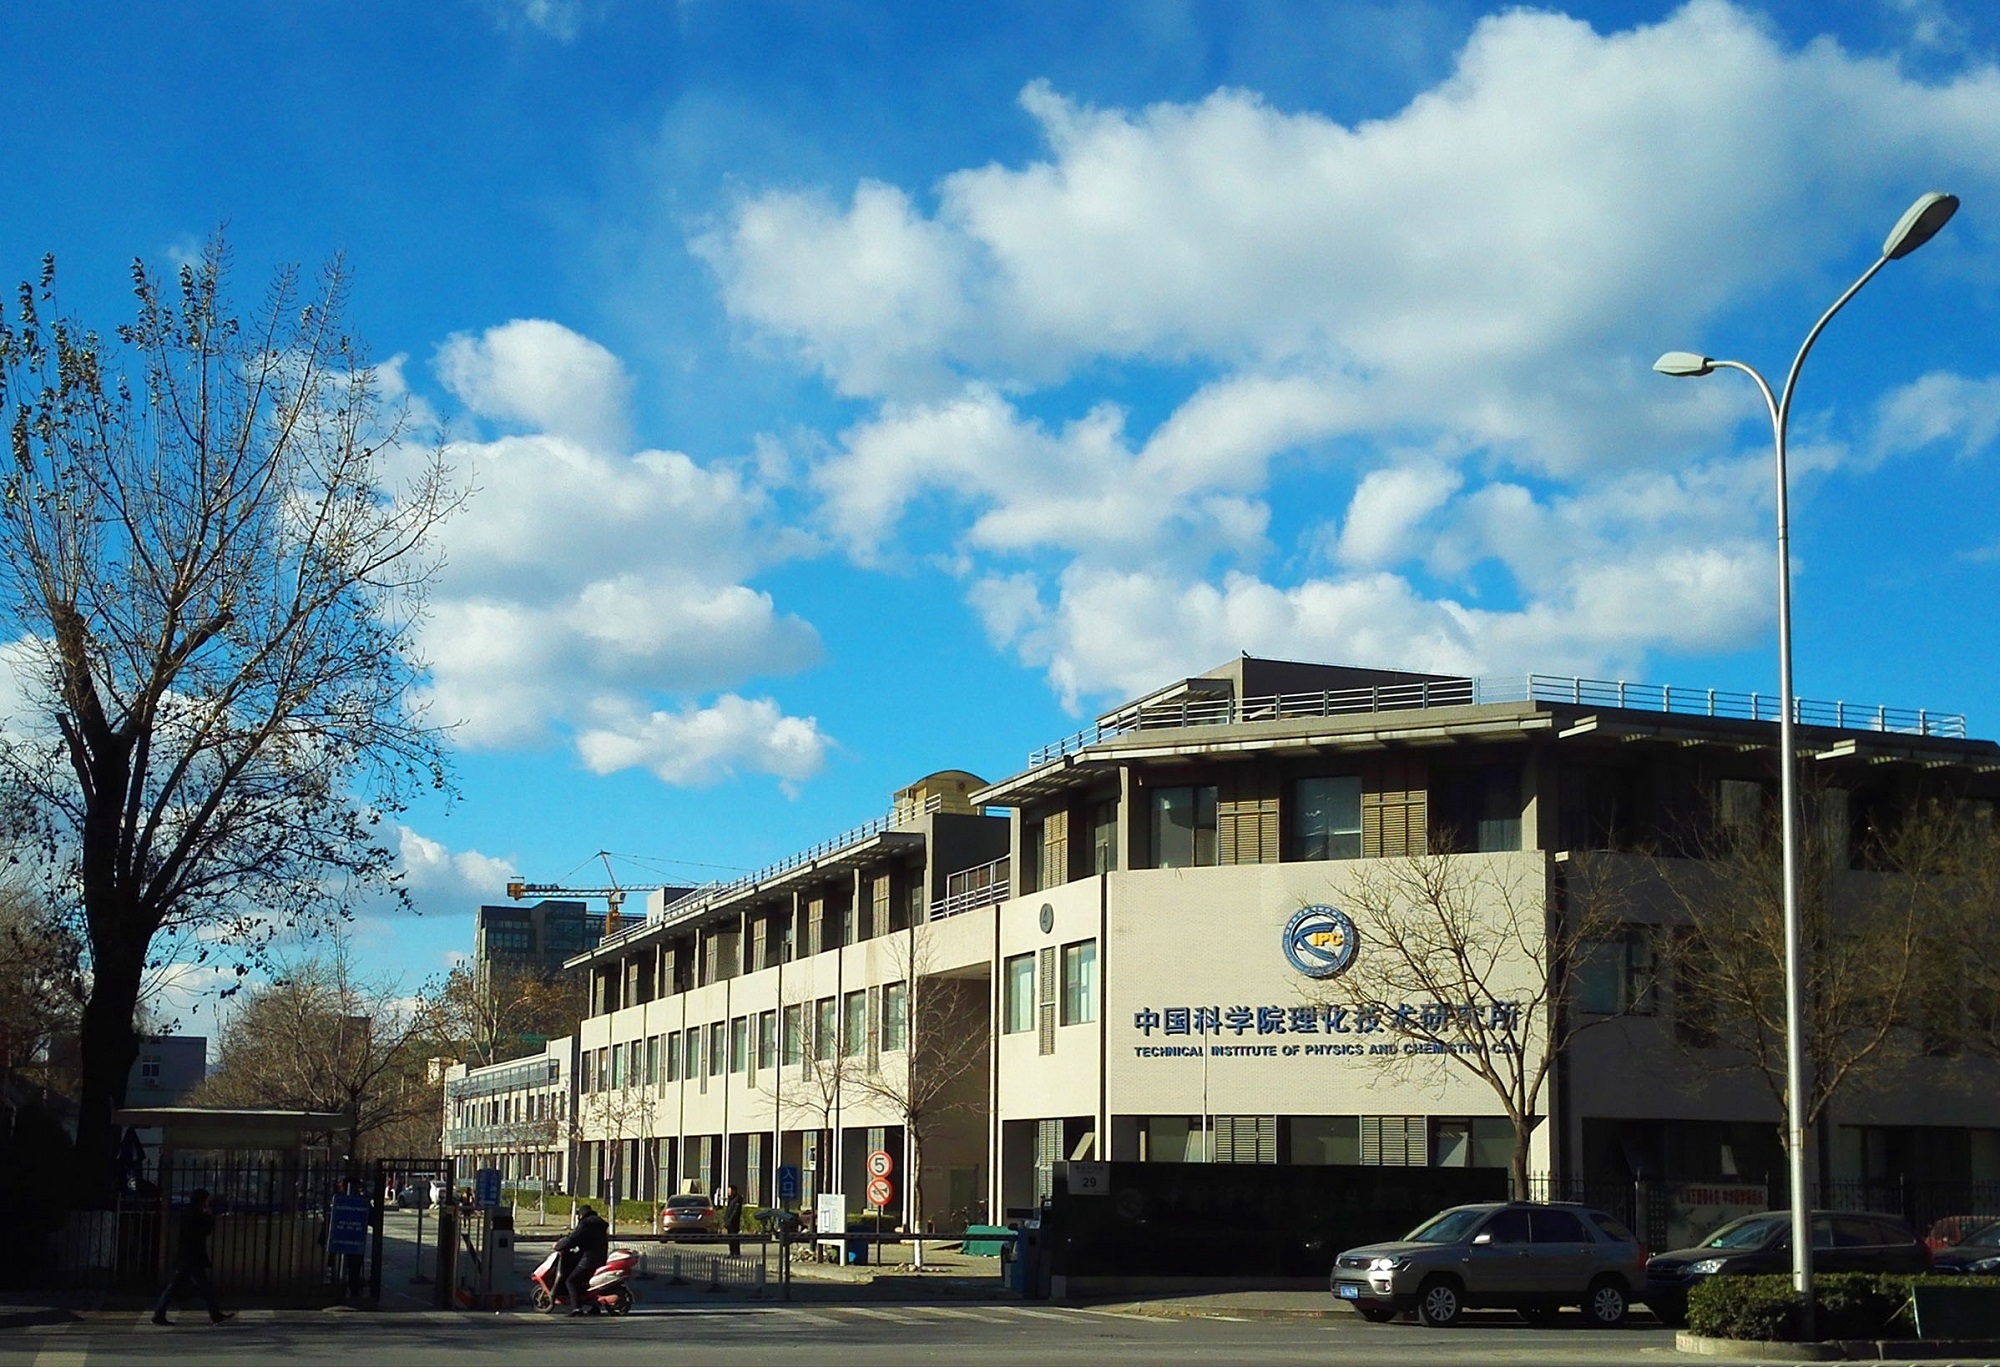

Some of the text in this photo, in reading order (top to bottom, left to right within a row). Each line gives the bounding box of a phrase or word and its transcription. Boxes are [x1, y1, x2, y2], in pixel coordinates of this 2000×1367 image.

[1312, 932, 1343, 946] IPC
[1134, 1046, 1204, 1058] TECHNICAL
[1210, 1046, 1277, 1057] INSTITUTE
[1282, 1045, 1300, 1056] OF
[1305, 1044, 1364, 1056] PHYSICS
[1369, 1044, 1398, 1055] AND
[1403, 1043, 1485, 1055] CHEMSTRY
[874, 1157, 885, 1173] 5
[782, 1168, 795, 1191] 入口
[1083, 1177, 1097, 1188] 29
